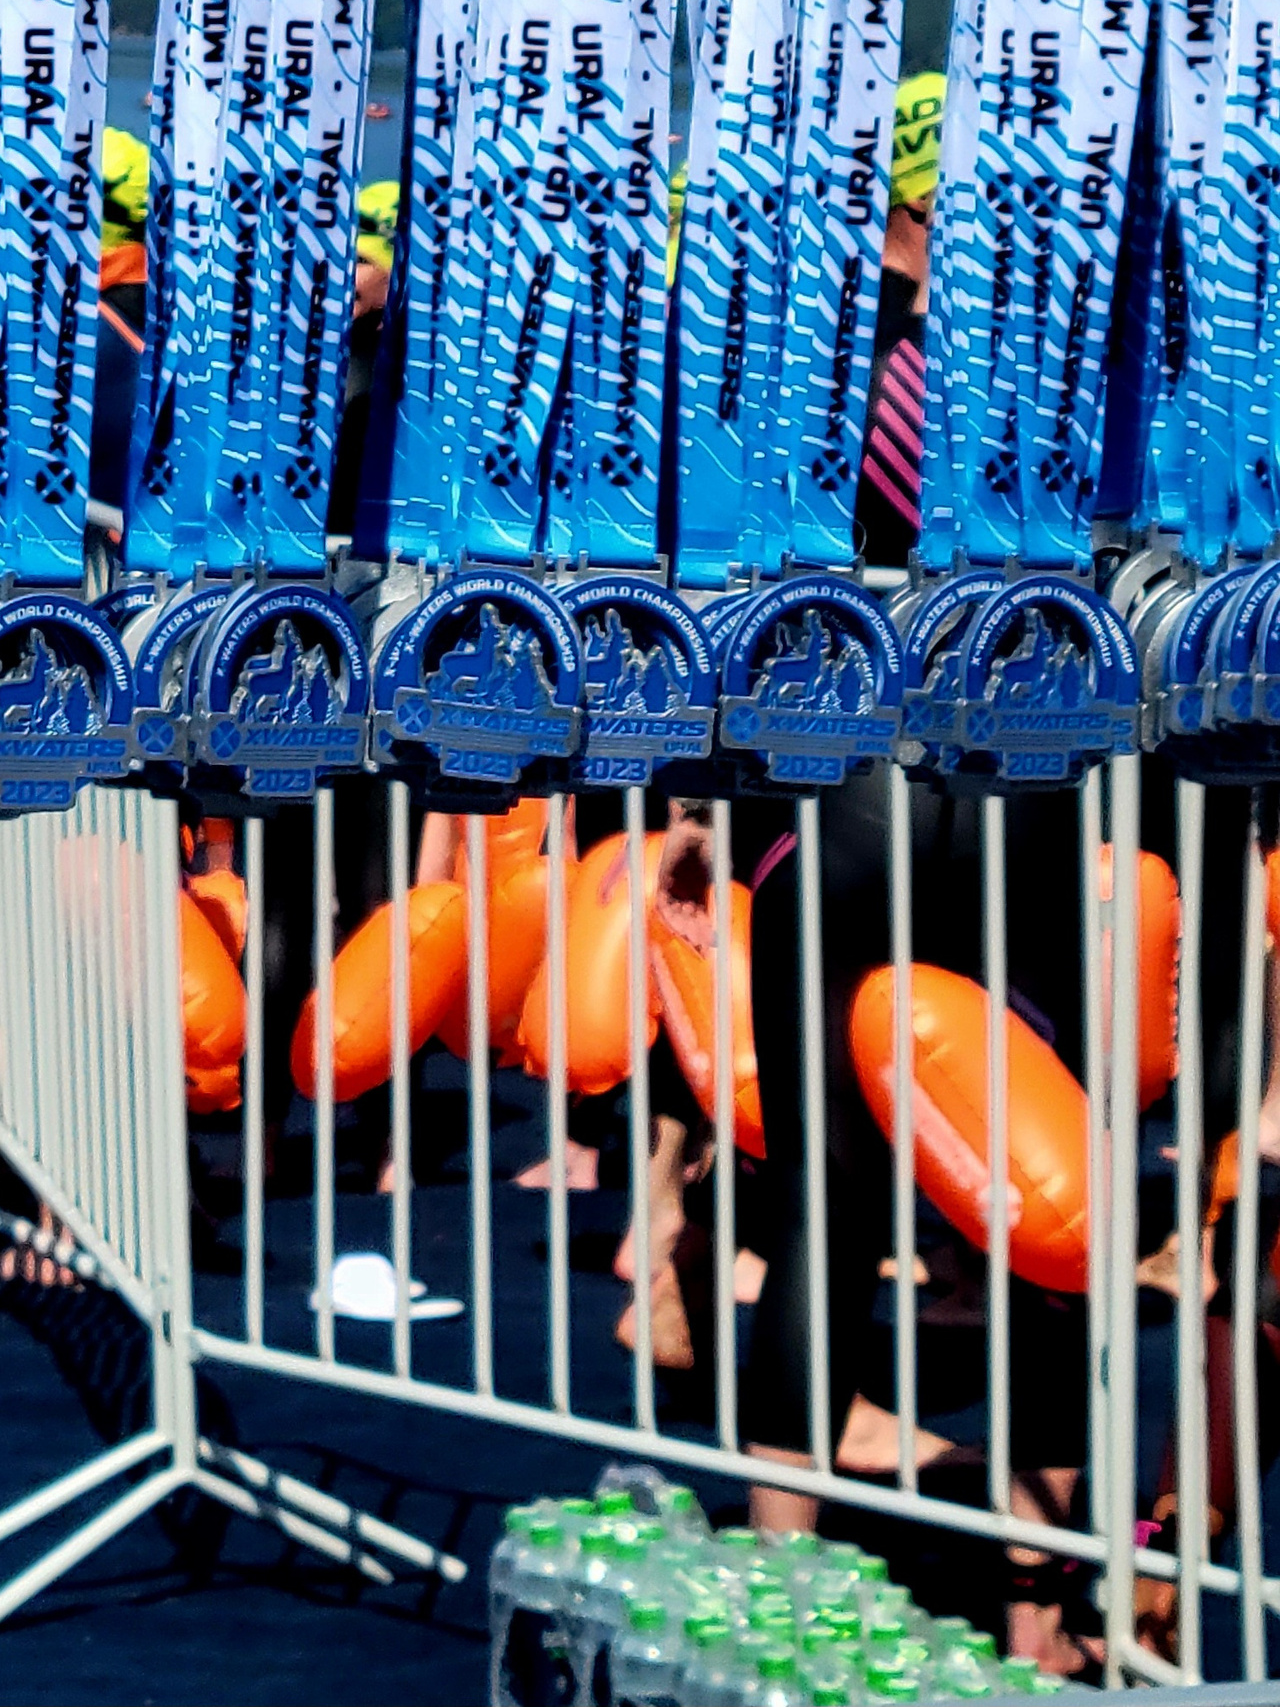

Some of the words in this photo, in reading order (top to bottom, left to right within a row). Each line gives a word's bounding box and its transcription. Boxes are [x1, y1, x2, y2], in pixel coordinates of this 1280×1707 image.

[283, 20, 314, 131] URAL
[516, 20, 550, 128] URAL
[572, 24, 605, 135] URAL
[639, 30, 657, 42] 1
[1187, 56, 1212, 69] 1
[25, 28, 54, 140] URAL
[239, 26, 267, 135] URAL
[1030, 32, 1059, 138] URAL
[69, 120, 93, 230] URAL
[82, 40, 98, 55] 1
[314, 118, 344, 228] URAL
[333, 40, 352, 54] 1
[628, 108, 654, 217] URAL
[847, 117, 881, 225] URAL
[864, 39, 886, 54] 1
[1080, 123, 1118, 230] URAL
[1100, 46, 1127, 60] 1
[3, 604, 53, 625] WORLD
[56, 607, 128, 692] CHAMPIONSHIP
[143, 607, 192, 673] X-WATERS
[217, 611, 257, 676] X-WATERS
[258, 596, 302, 615] WORLD
[404, 590, 453, 654] X-WATERS
[453, 579, 503, 596] WORLD
[506, 581, 576, 672] CHAMPIONSHIP
[577, 586, 630, 604] WORLD
[633, 589, 711, 674] CHAMPIONSHIP
[733, 597, 780, 662] X-WATERS
[782, 586, 830, 603] WORLD
[912, 596, 957, 655] X-WATERS
[957, 581, 1002, 597] WORLD
[970, 601, 1011, 666] X-WATERS
[1011, 585, 1052, 605] WORLD
[1, 780, 71, 803] 2023
[252, 769, 309, 791] 2023
[445, 748, 515, 776] 2023
[773, 755, 842, 779] 2023
[1008, 754, 1065, 775] 2023
